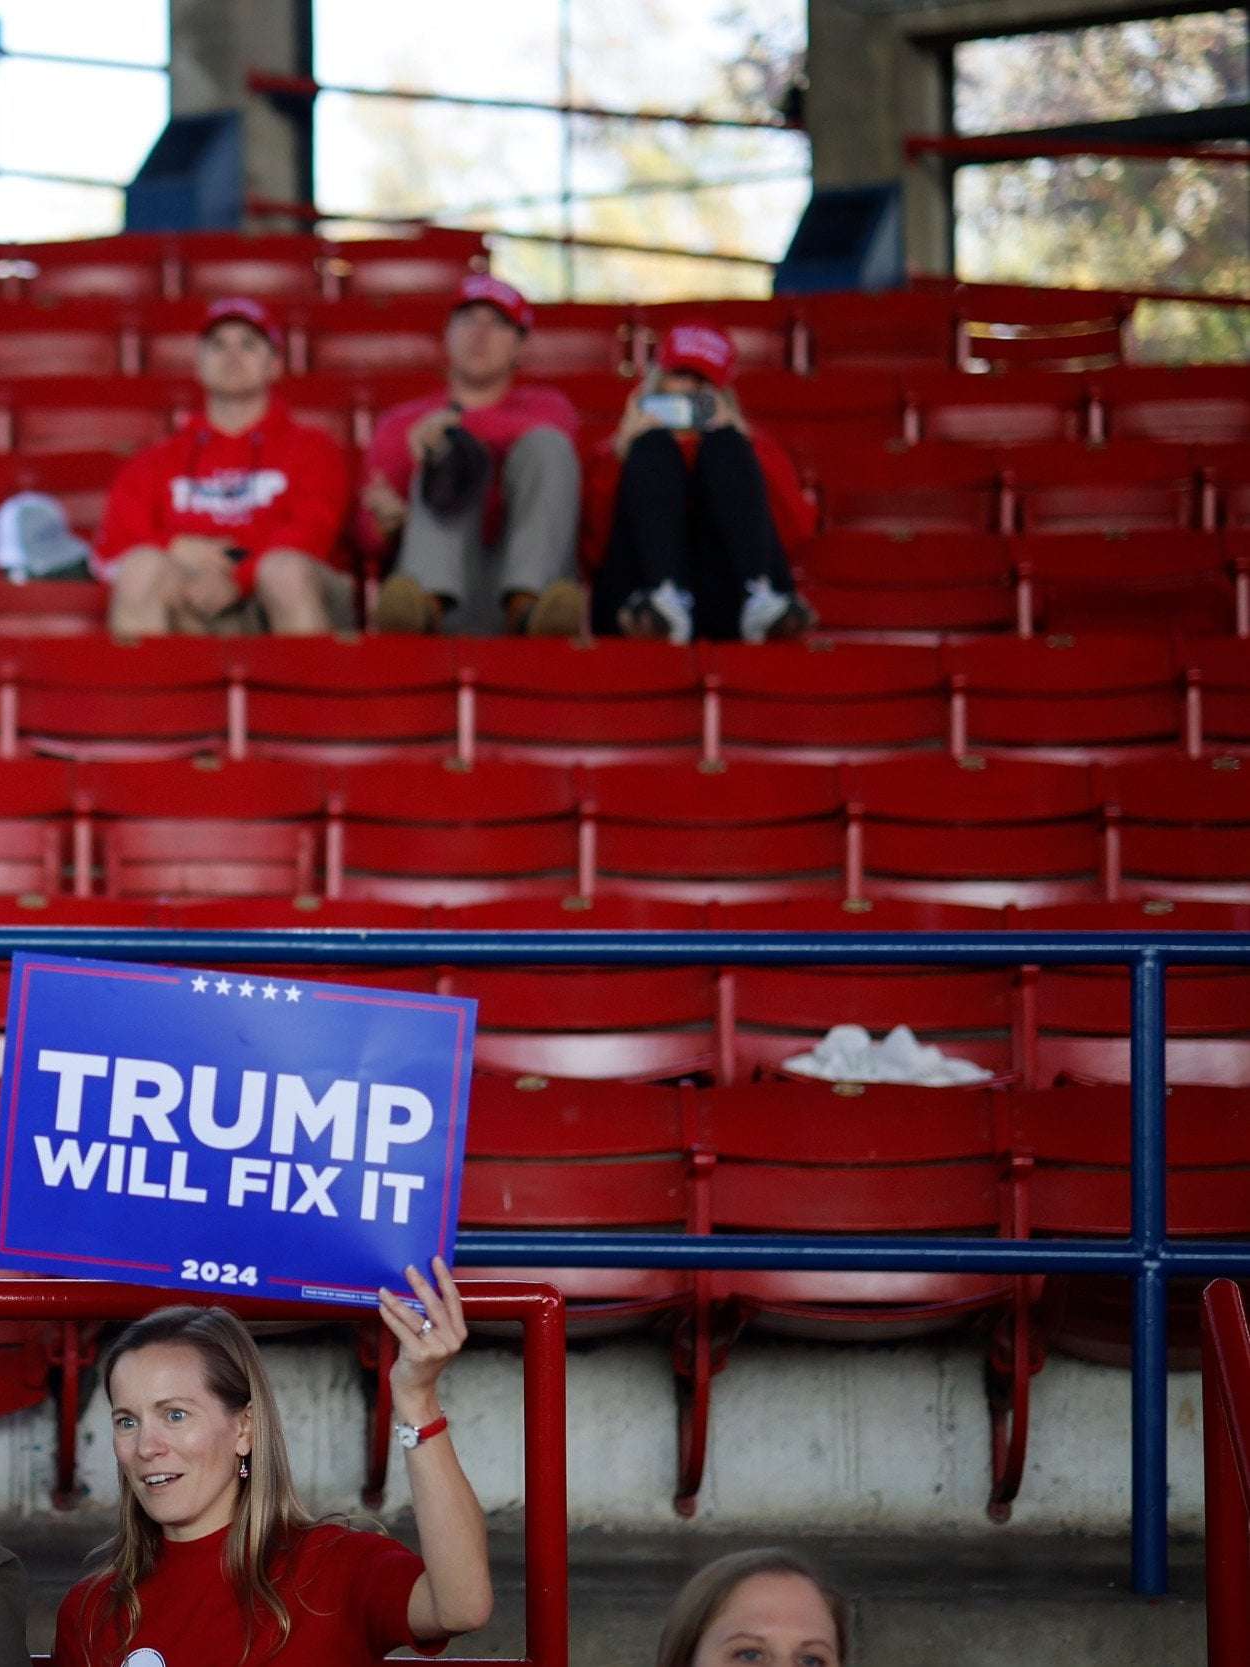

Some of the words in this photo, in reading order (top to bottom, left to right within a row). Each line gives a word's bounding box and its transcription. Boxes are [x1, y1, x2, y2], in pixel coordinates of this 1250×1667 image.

[37, 1049, 434, 1164] TRUMP
[34, 1135, 207, 1203] WILL
[227, 1157, 342, 1218] FIX
[360, 1171, 425, 1224] IT
[180, 1259, 258, 1287] 2024
